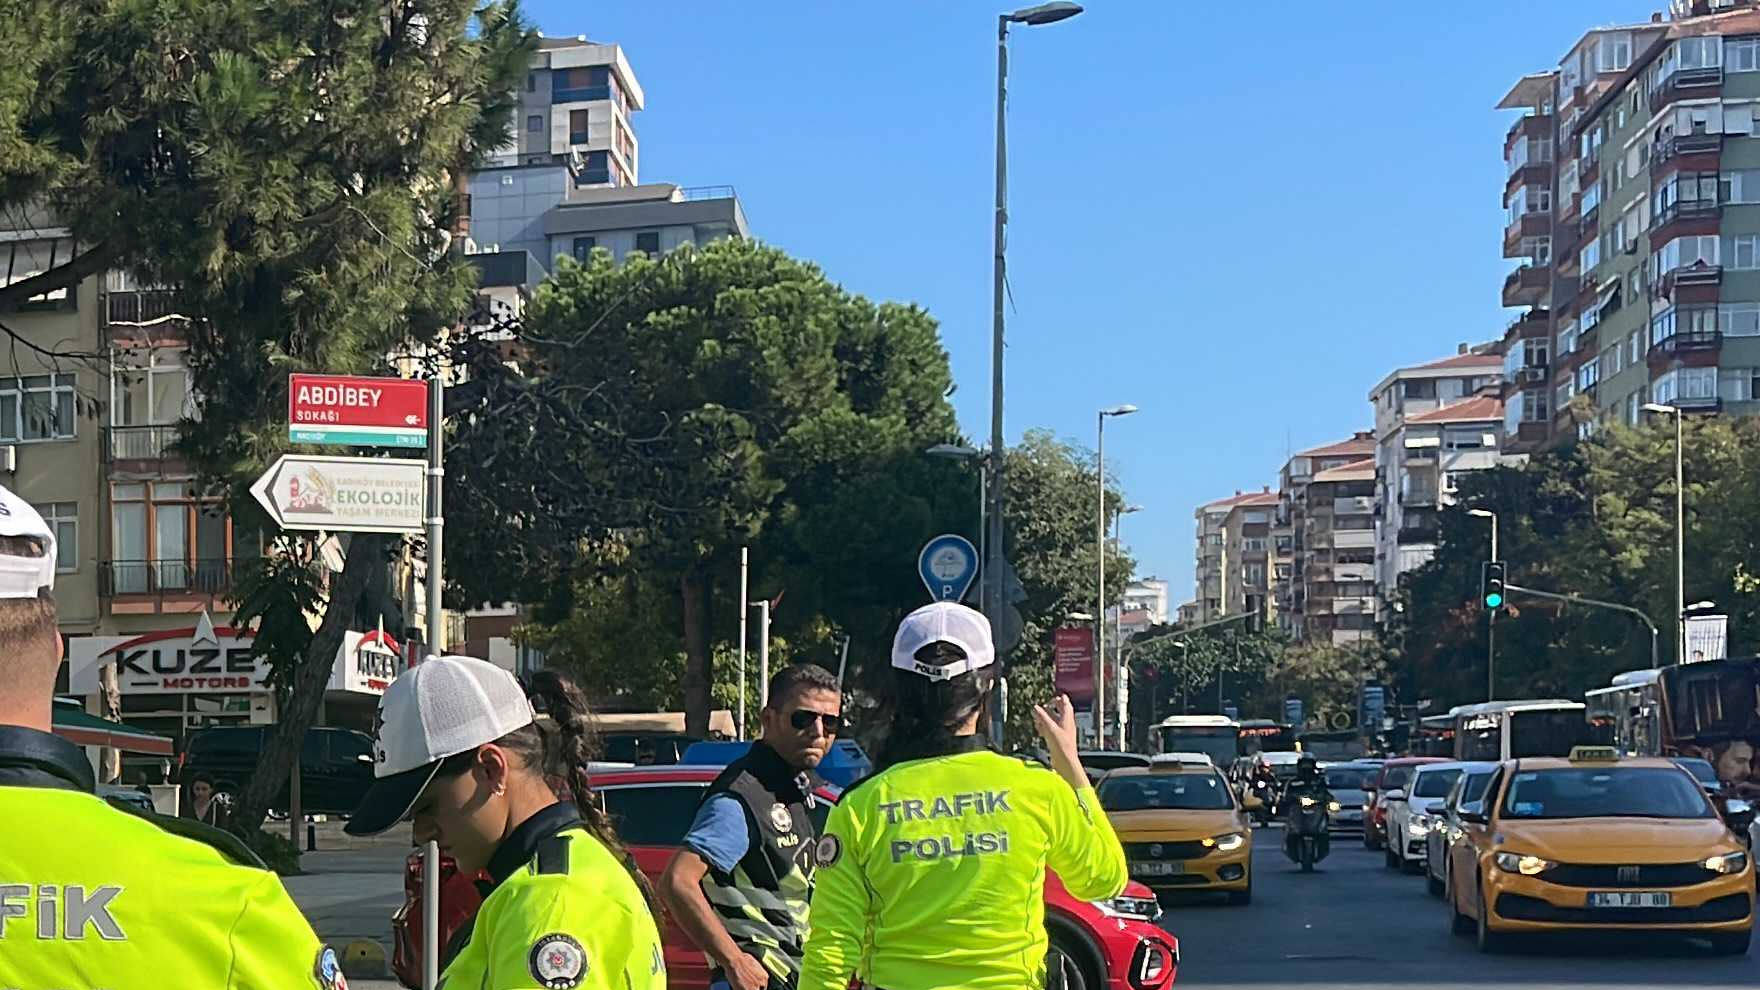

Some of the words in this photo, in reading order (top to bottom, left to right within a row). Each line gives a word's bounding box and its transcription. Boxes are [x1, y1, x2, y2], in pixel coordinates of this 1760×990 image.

[298, 384, 381, 407] ABDİBEY
[296, 410, 339, 422] SOKAĞI
[336, 489, 421, 506] EKOLOJİK
[942, 584, 953, 598] P
[116, 648, 256, 675] KUZE
[163, 677, 250, 689] MOTORS
